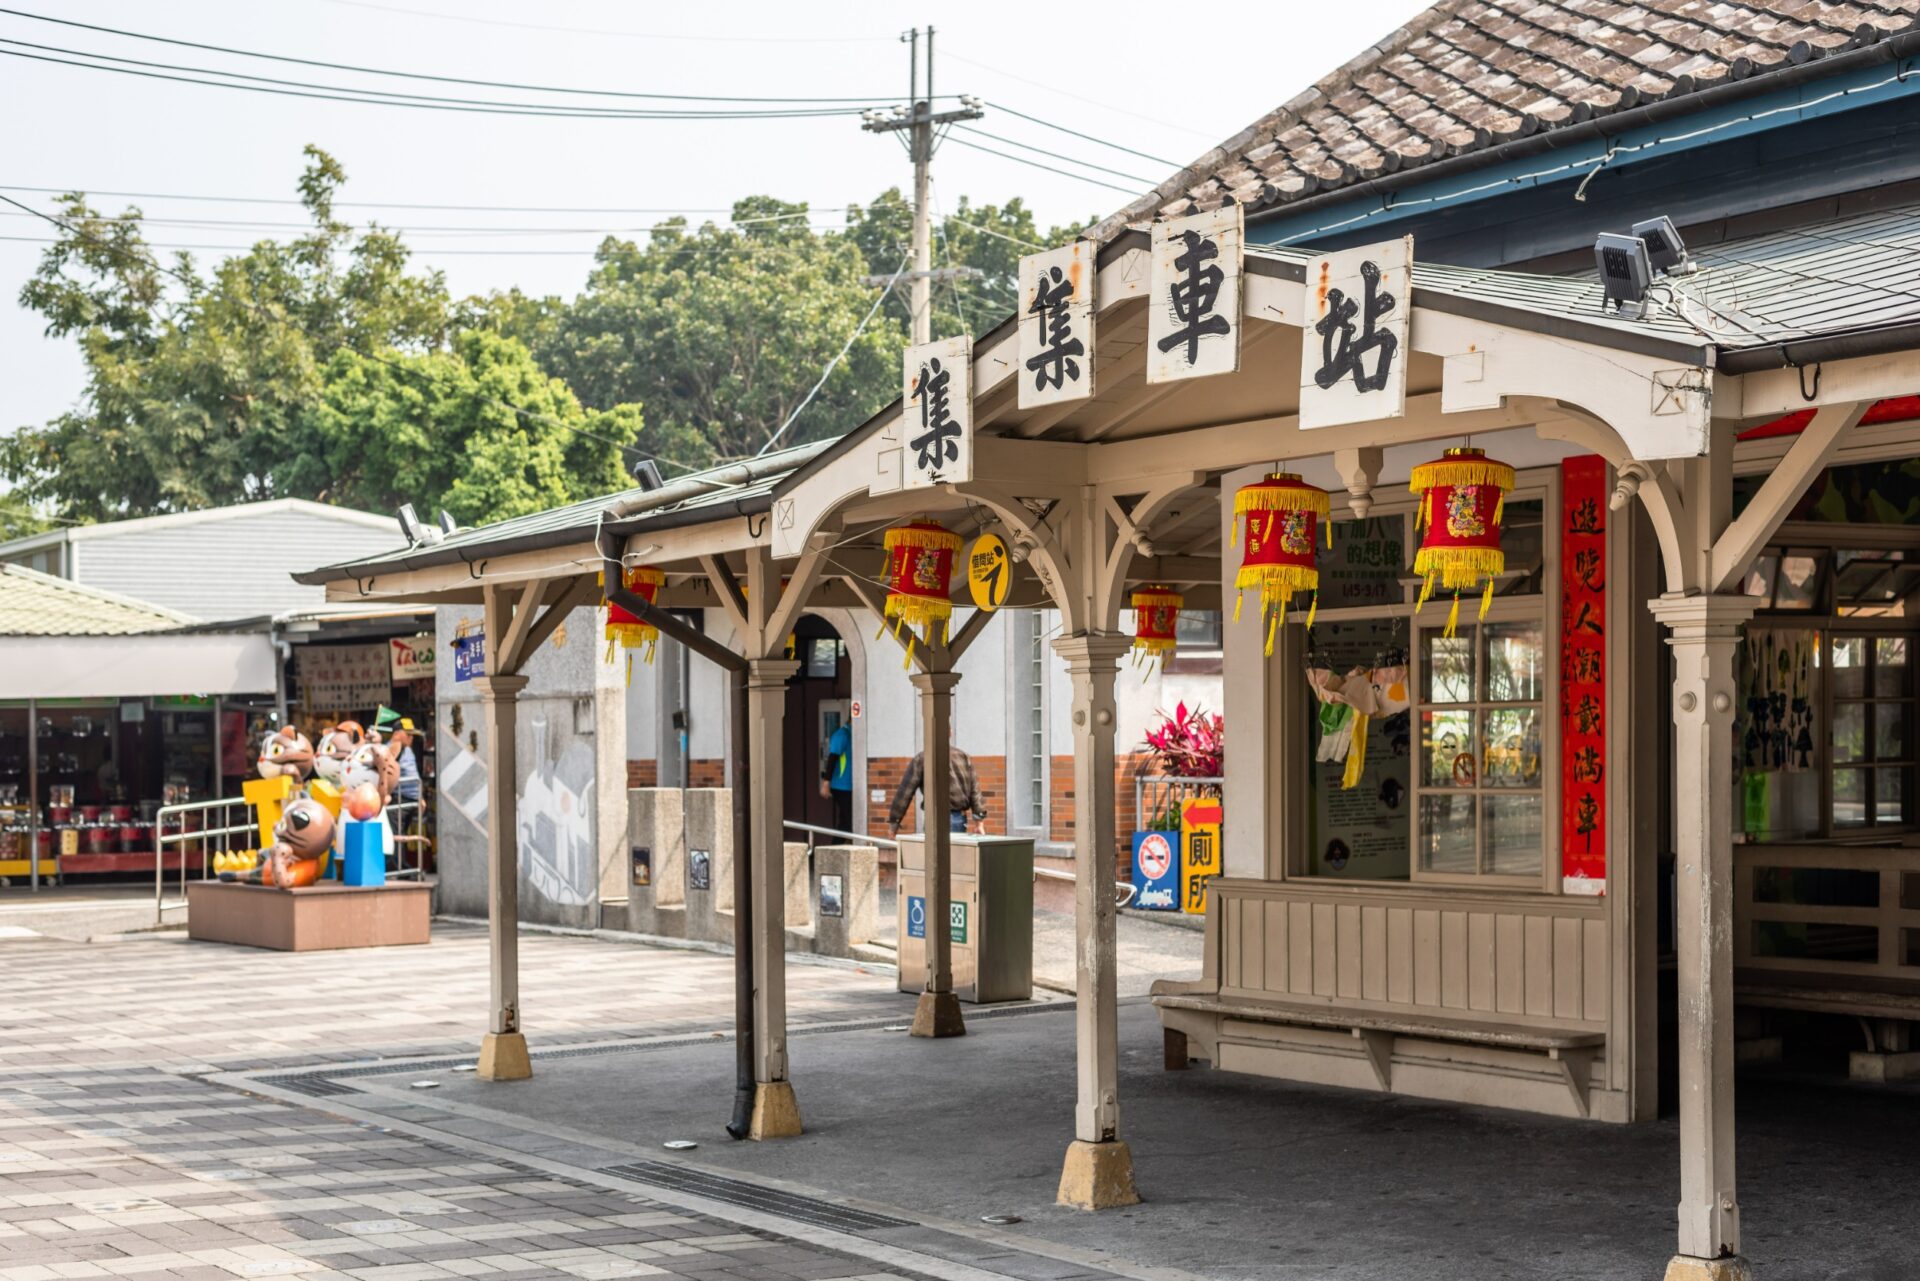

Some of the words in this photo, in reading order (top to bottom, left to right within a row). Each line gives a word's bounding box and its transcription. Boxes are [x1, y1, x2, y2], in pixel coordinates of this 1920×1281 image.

[910, 230, 1398, 470] 集集車站
[1187, 829, 1212, 909] 廁所
